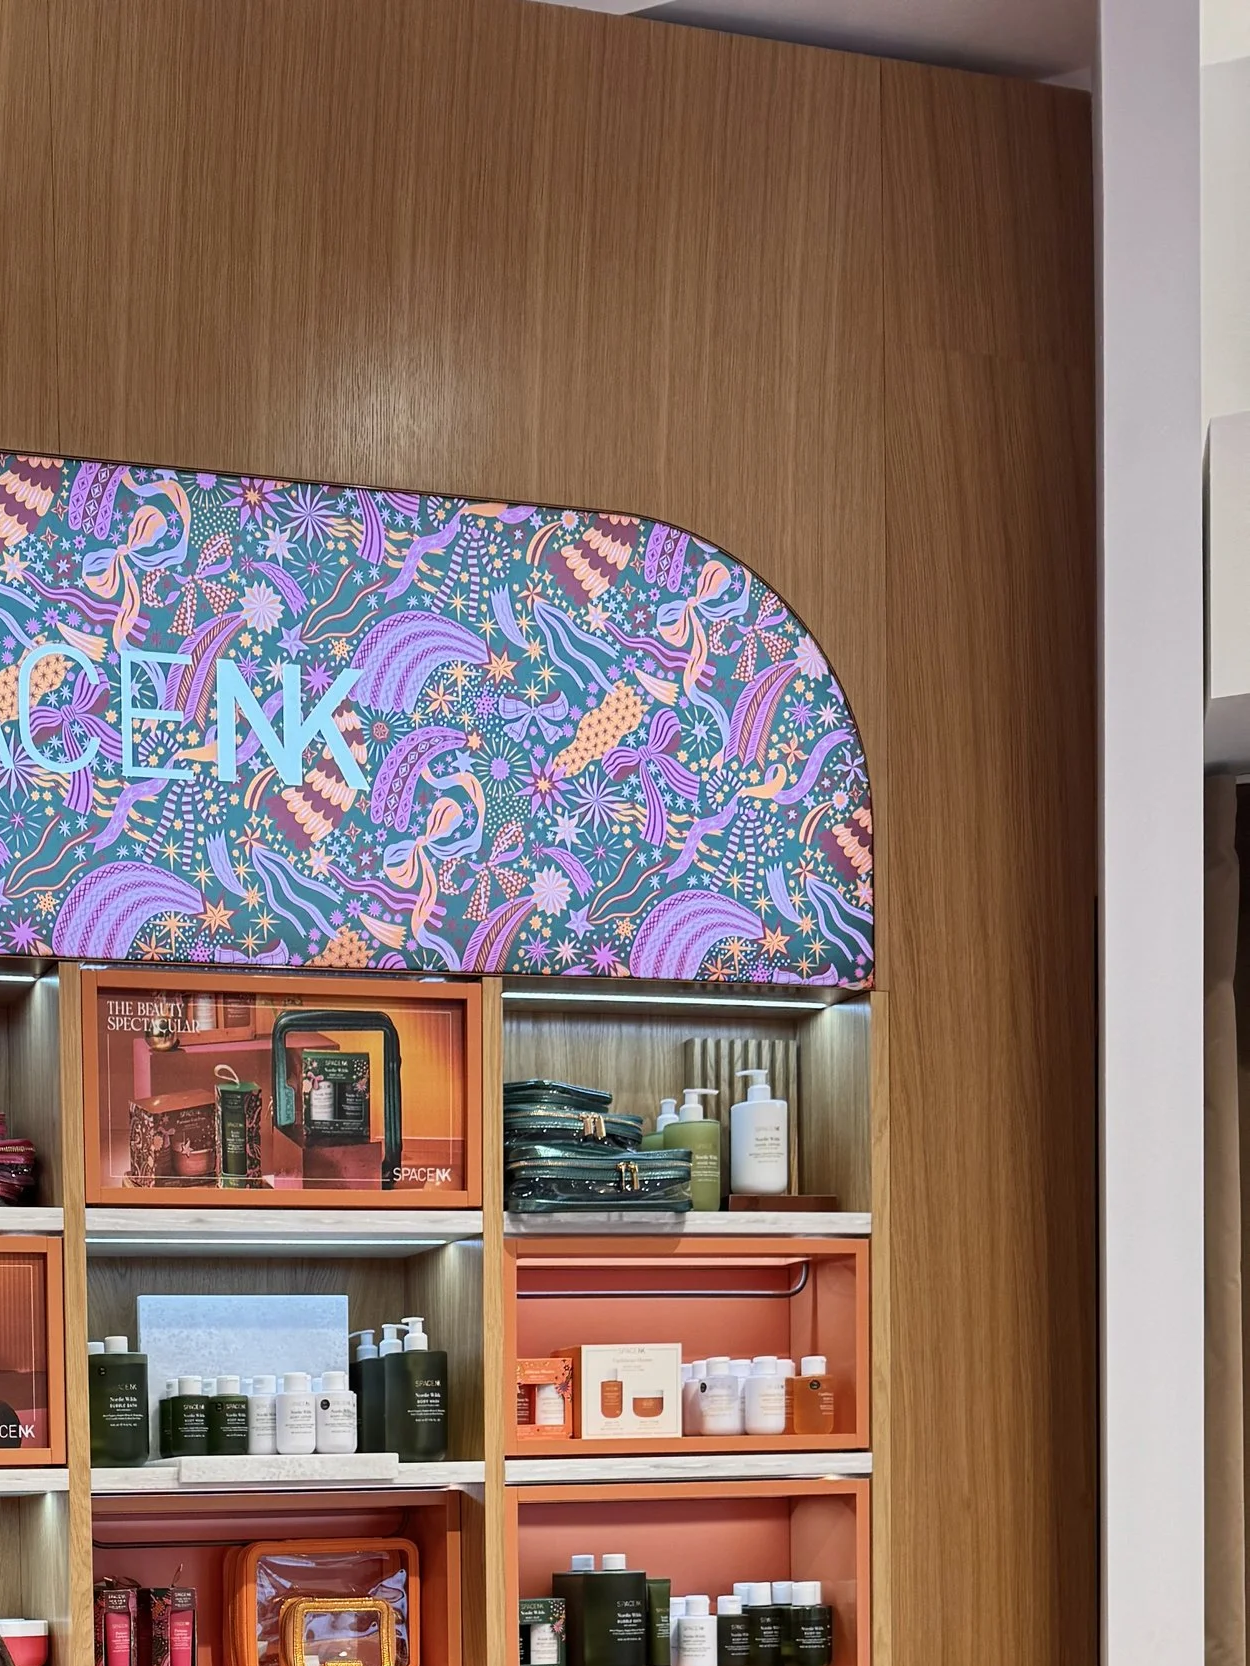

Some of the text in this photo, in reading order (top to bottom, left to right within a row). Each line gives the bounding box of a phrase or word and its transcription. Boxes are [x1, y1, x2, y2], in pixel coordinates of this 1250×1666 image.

[107, 1001, 184, 1018] THE BEAUTY
[107, 1016, 200, 1034] SPECTACULAR
